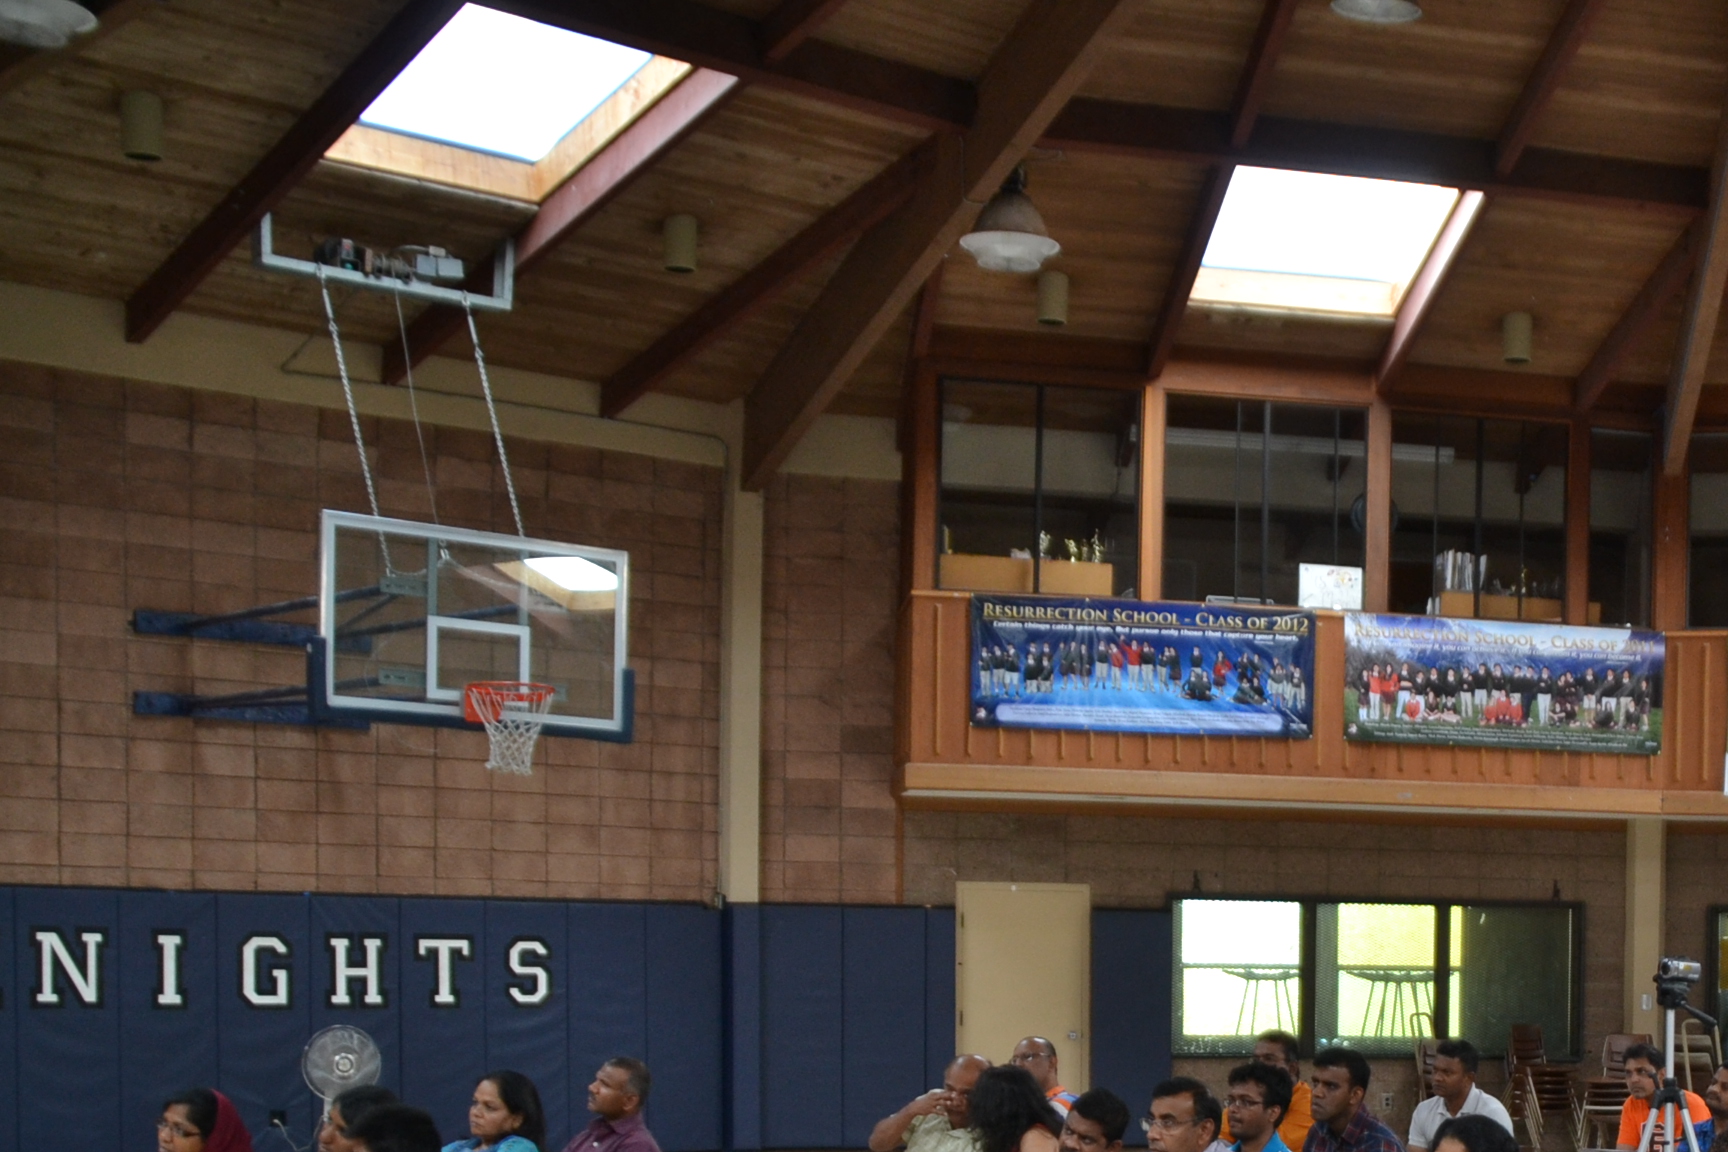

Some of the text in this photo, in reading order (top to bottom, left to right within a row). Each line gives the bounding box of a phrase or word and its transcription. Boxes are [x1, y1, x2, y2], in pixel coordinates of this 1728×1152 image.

[984, 602, 1107, 621] RESURRECTION
[1113, 608, 1180, 625] SCHOOL
[1195, 611, 1243, 628] CLASS
[1247, 616, 1268, 630] OF
[1272, 616, 1309, 632] 2012
[993, 620, 1023, 629] Certain
[1024, 622, 1051, 631] things
[1052, 623, 1074, 631] catch
[1160, 628, 1179, 637] only
[1204, 629, 1222, 638] that
[1354, 622, 1469, 643] RESURRECTION
[1475, 631, 1537, 647] SCHOOL
[1551, 635, 1595, 651] CLASS
[1599, 641, 1618, 652] OF
[1622, 638, 1656, 654] 2011
